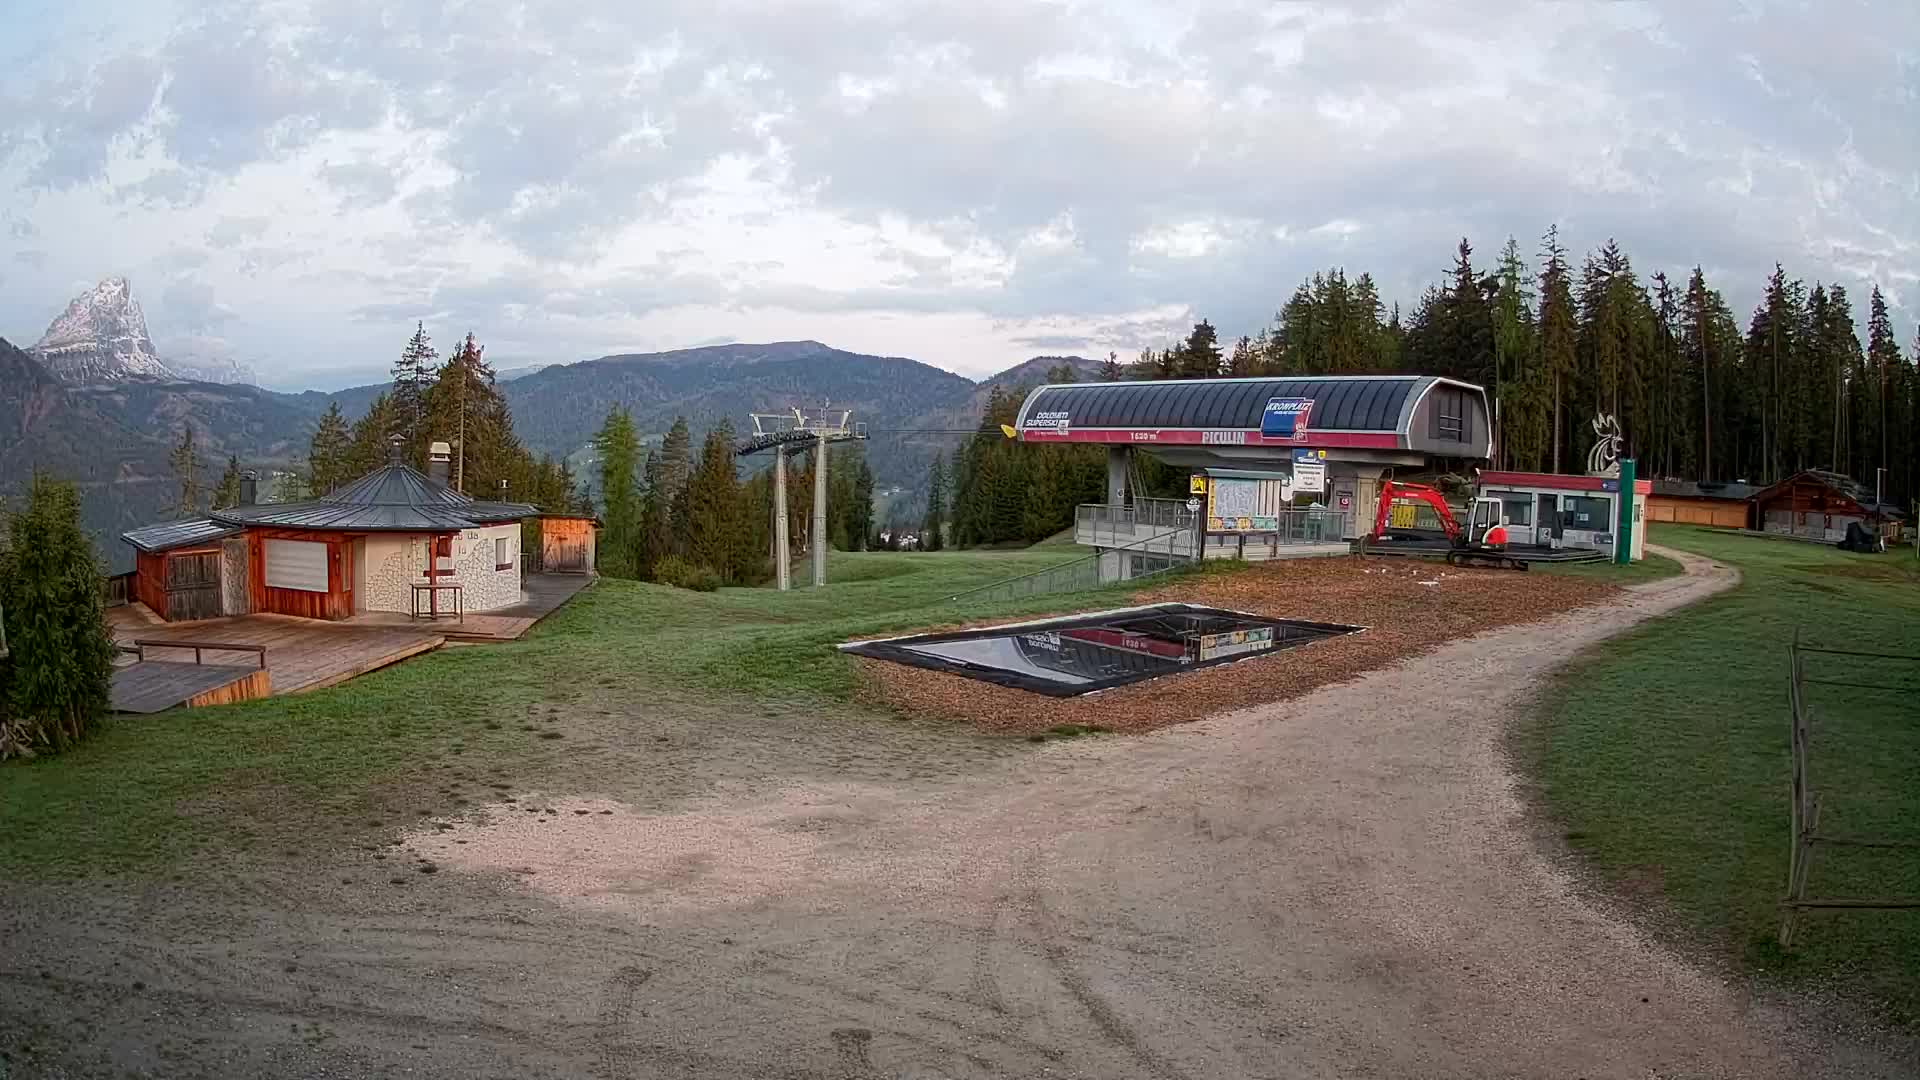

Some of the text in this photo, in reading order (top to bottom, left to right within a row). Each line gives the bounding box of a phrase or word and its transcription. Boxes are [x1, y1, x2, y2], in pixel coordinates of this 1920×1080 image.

[1036, 411, 1069, 419] DOLOMITI
[1025, 419, 1058, 427] SUPERSKI
[1201, 432, 1245, 445] PICULIN
